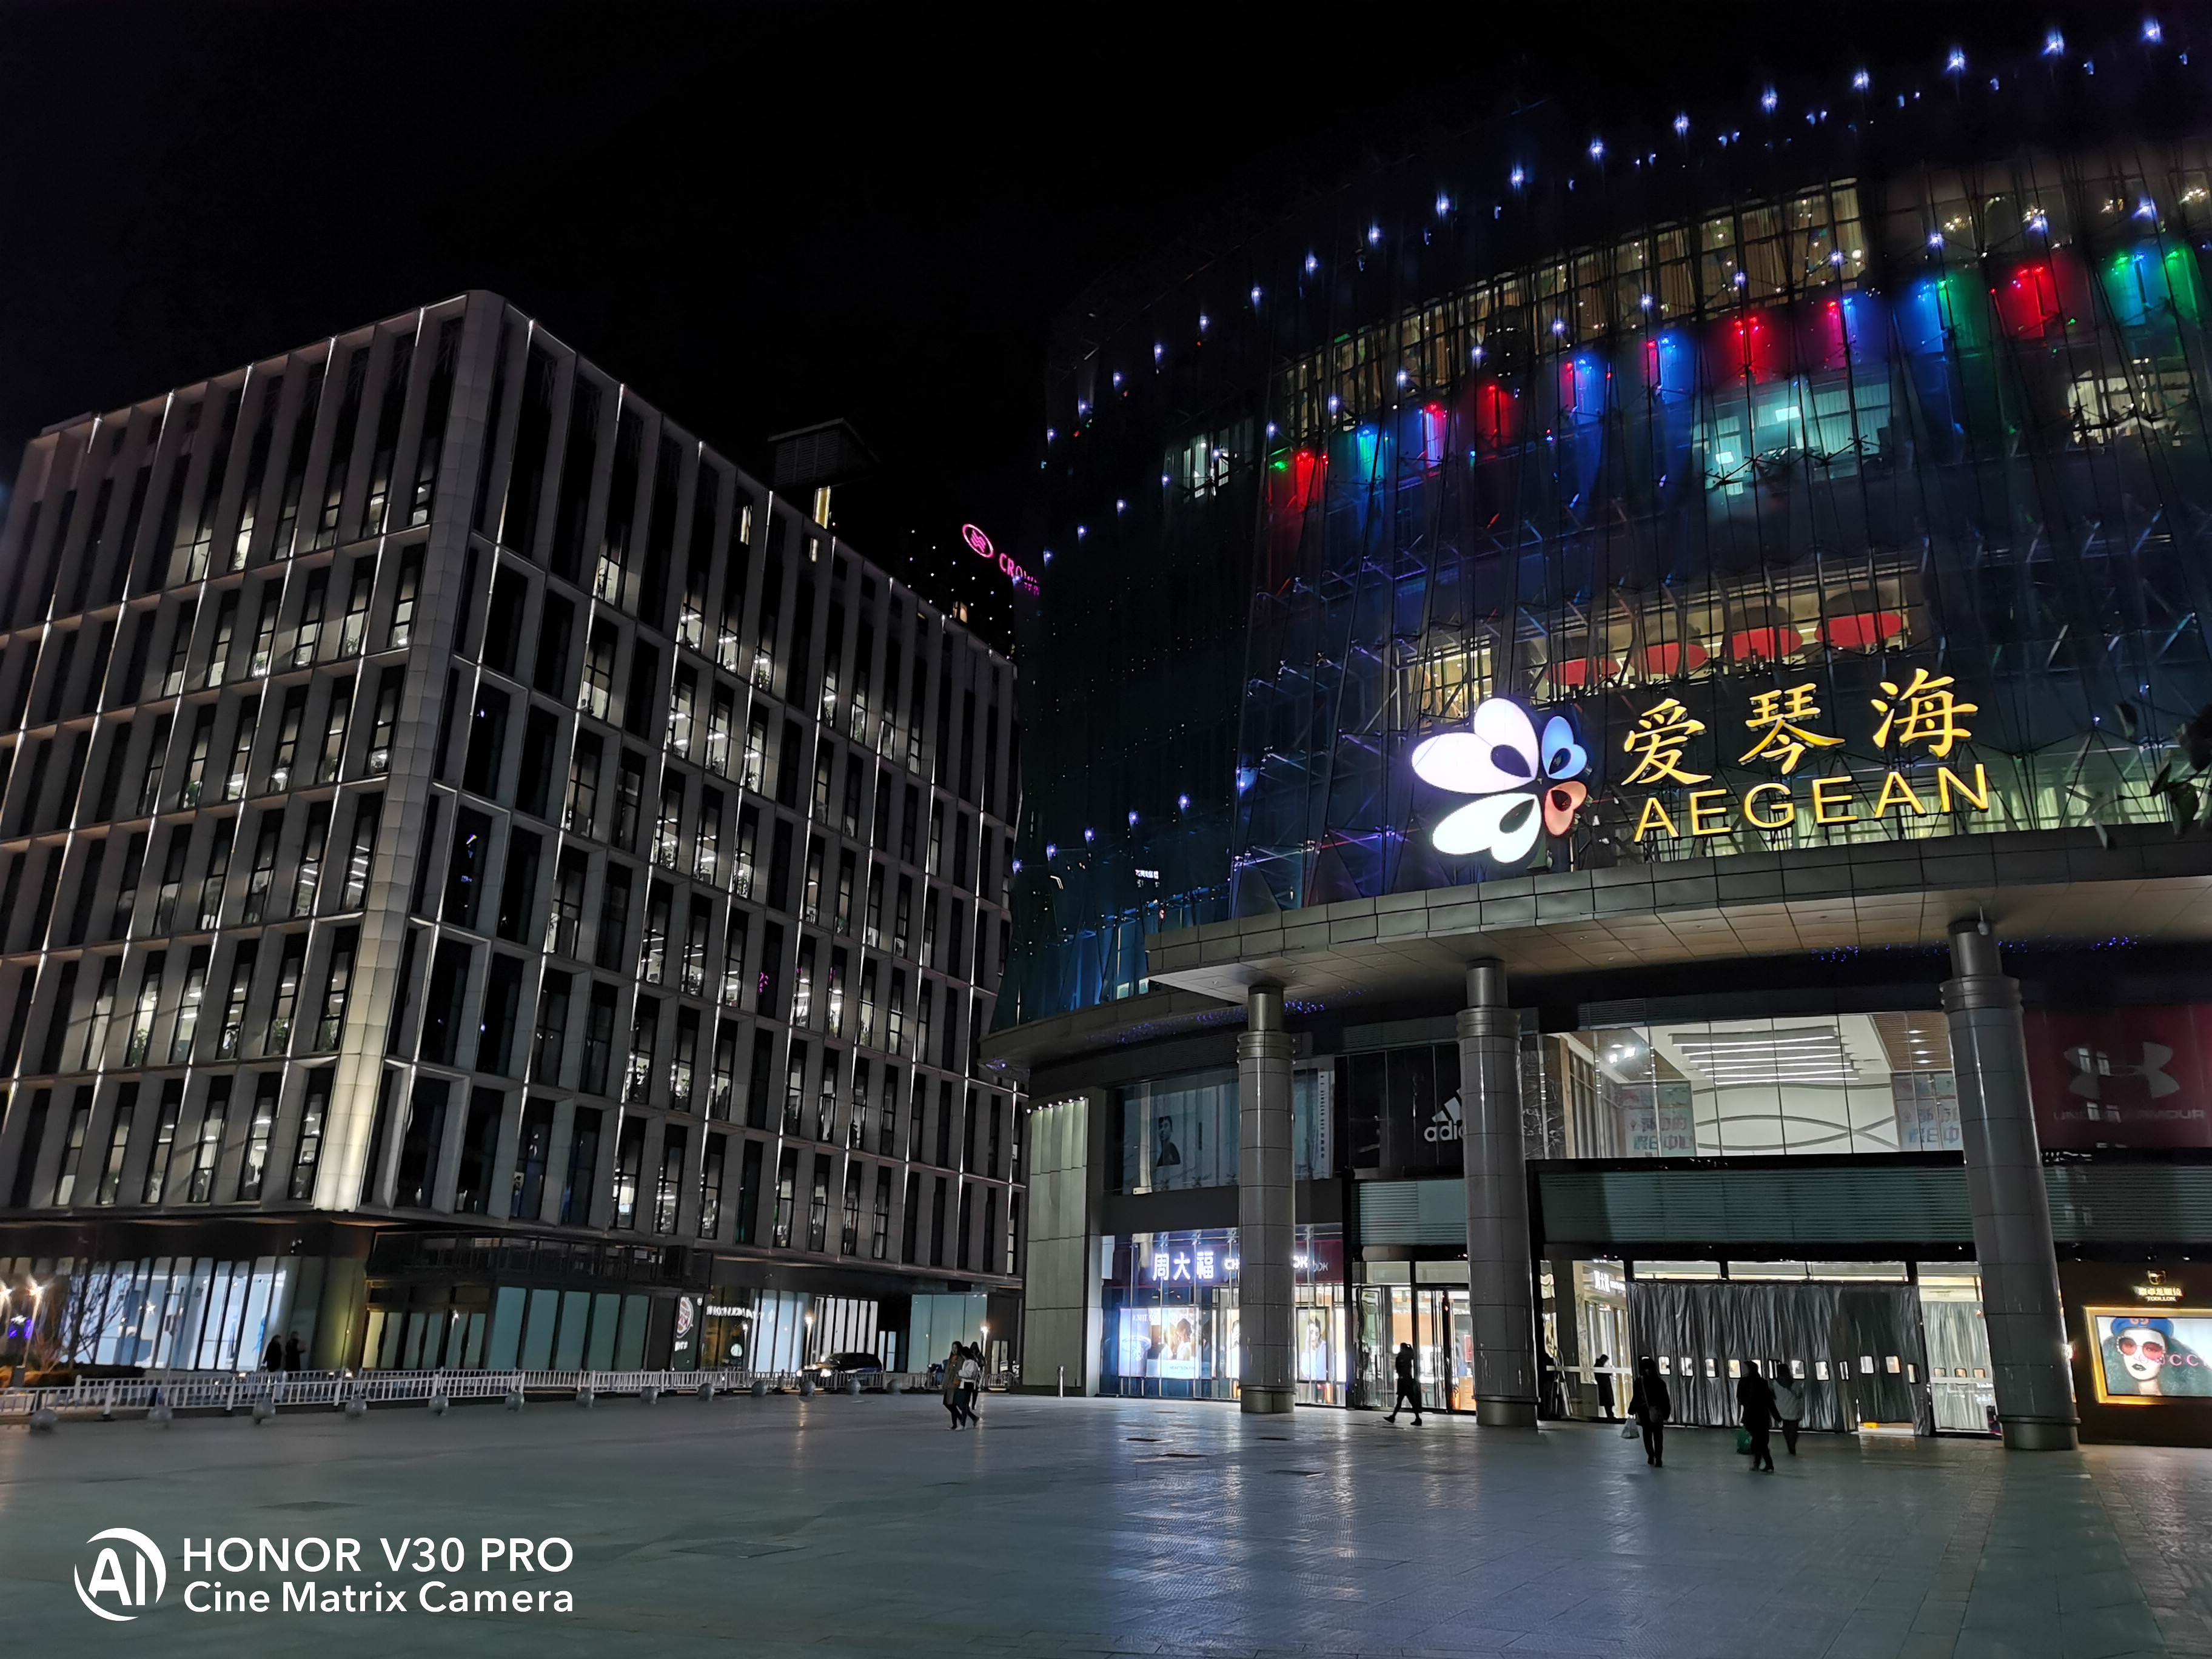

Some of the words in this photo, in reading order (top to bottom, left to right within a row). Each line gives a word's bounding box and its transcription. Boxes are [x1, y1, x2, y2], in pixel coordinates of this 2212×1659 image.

[1622, 668, 1978, 785] 爱琴海
[1634, 763, 1989, 842] AEGEAN
[1424, 1121, 1463, 1142] adi
[1153, 1251, 1214, 1280] 周大福
